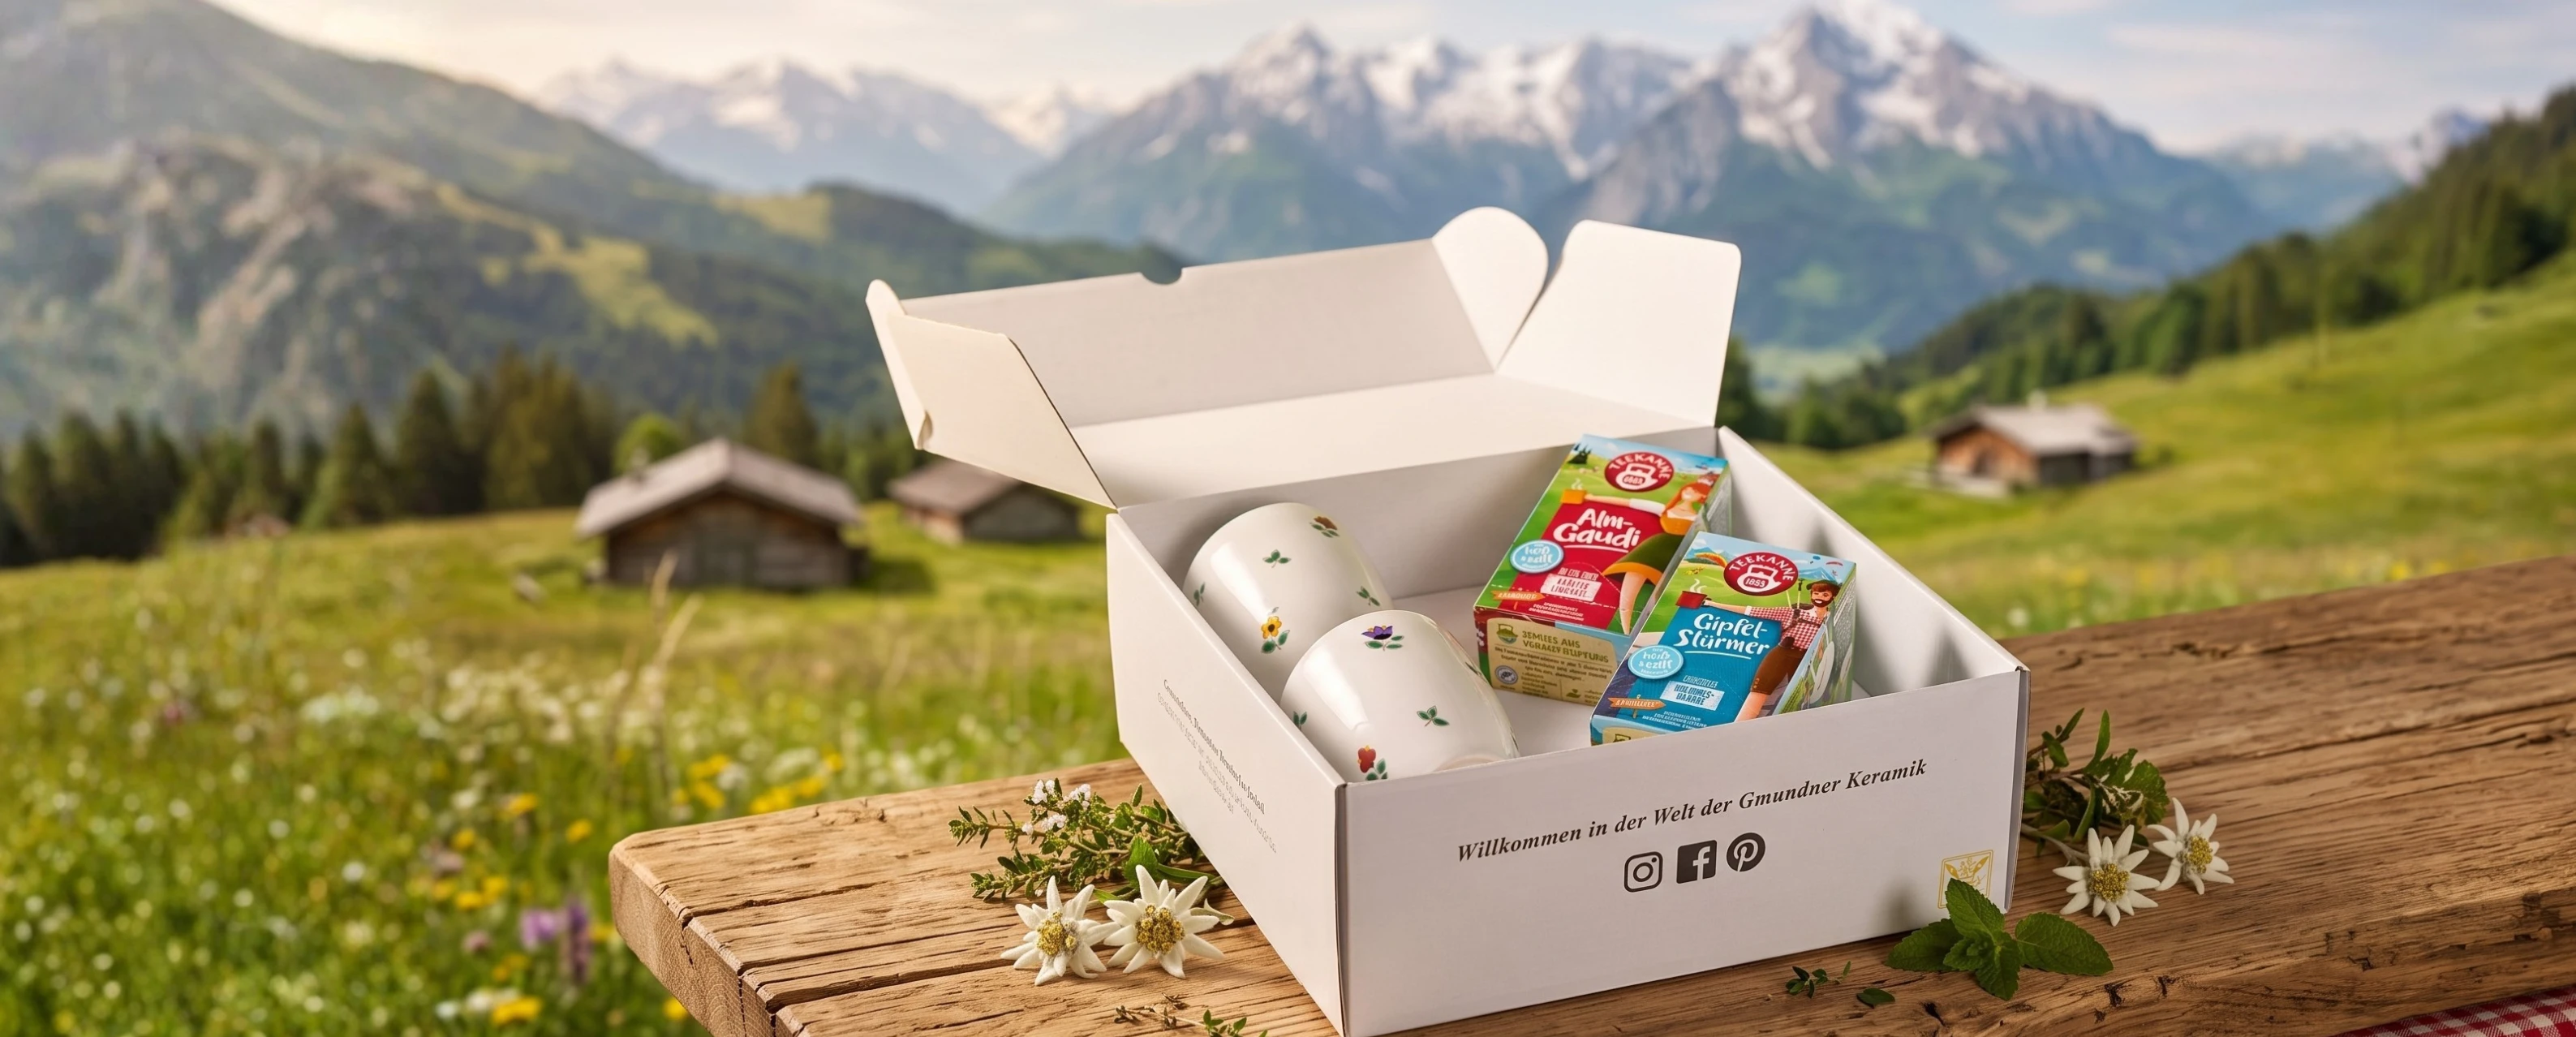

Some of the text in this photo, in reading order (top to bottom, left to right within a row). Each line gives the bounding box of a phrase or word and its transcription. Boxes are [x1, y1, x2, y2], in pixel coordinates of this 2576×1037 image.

[1608, 453, 1672, 480] TEEKANNE
[1576, 508, 1633, 530] Alm-
[1553, 523, 1641, 549] Gaudi
[1728, 554, 1796, 582] TEEKANNE
[1693, 613, 1768, 639] Gipfel-
[1673, 629, 1770, 655] Stürmer
[1458, 759, 1928, 863] Willkommen in der Welt der Gmundner Keramik
